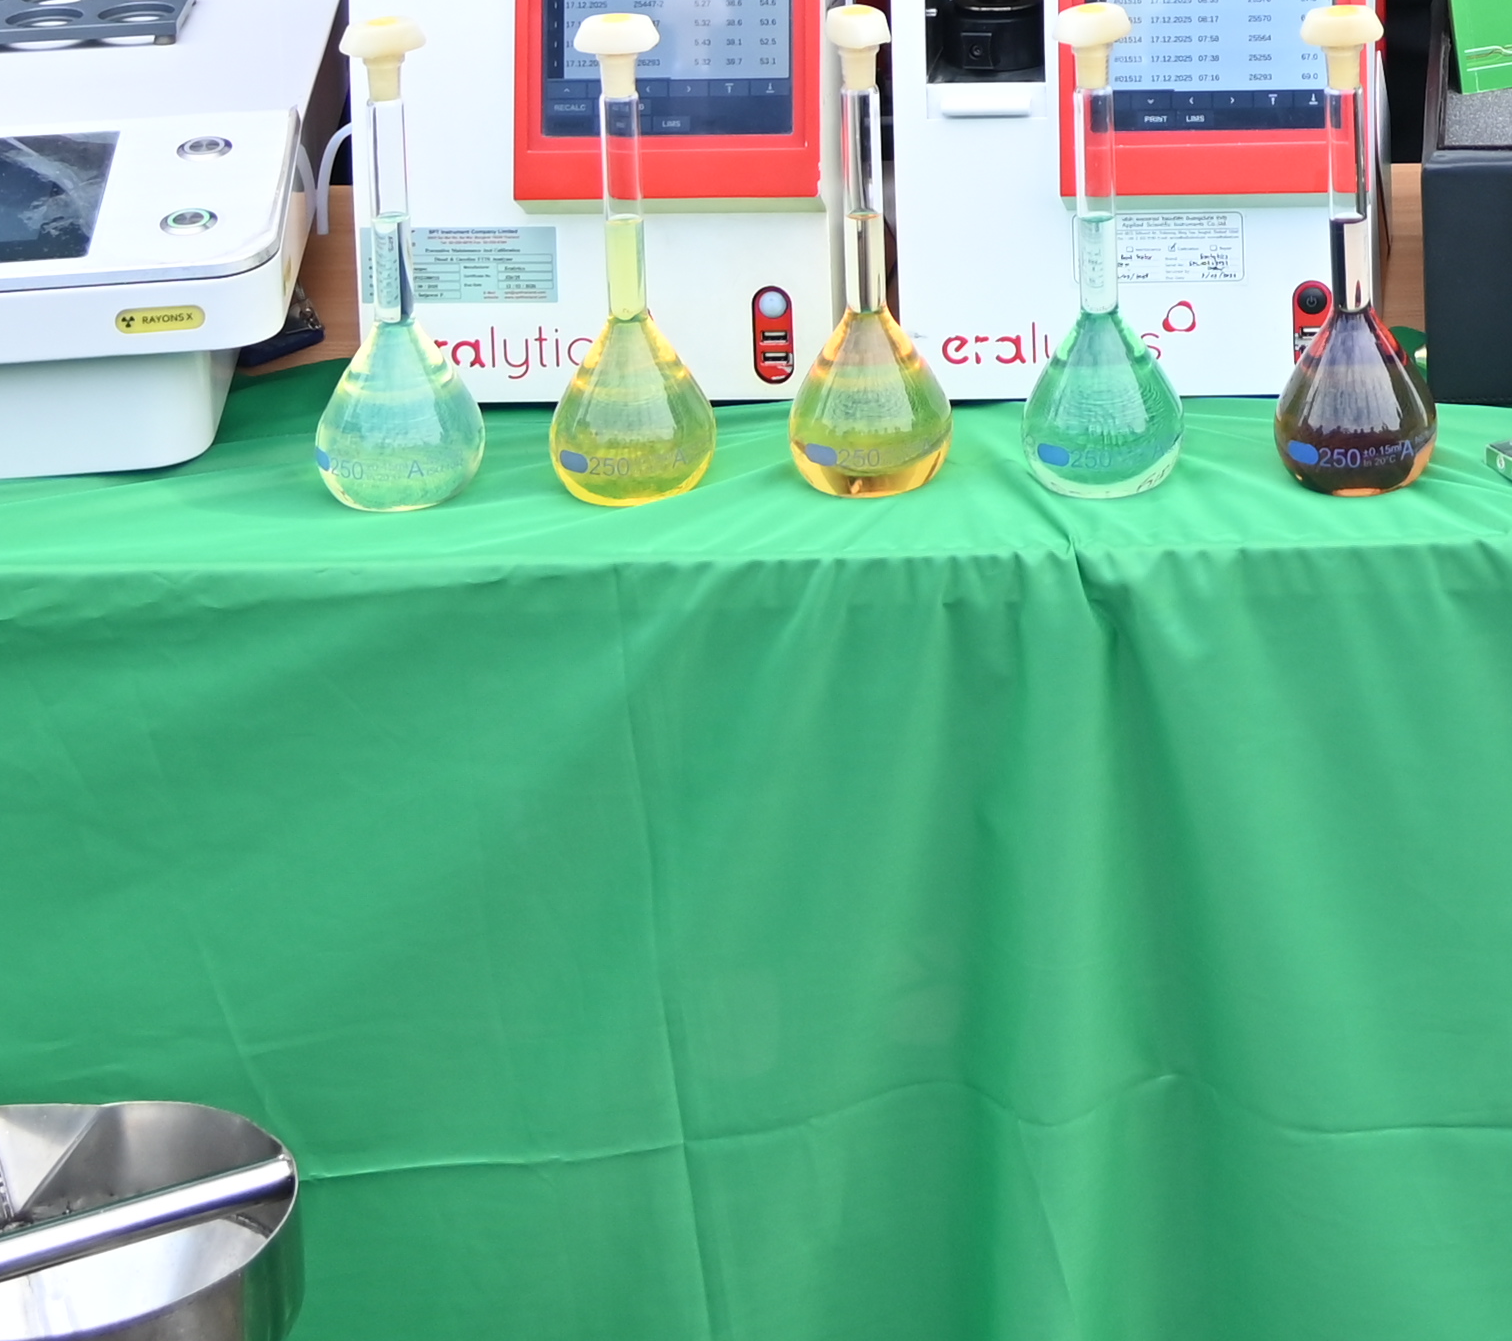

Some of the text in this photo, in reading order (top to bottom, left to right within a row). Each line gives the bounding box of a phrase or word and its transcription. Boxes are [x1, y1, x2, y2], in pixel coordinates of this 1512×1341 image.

[142, 313, 184, 325] RAYONS
[838, 447, 881, 467] 250
[1070, 448, 1112, 468] 250
[1318, 447, 1361, 468] 250
[1401, 440, 1414, 461] A
[331, 456, 364, 481] 250
[589, 456, 630, 477] 250
